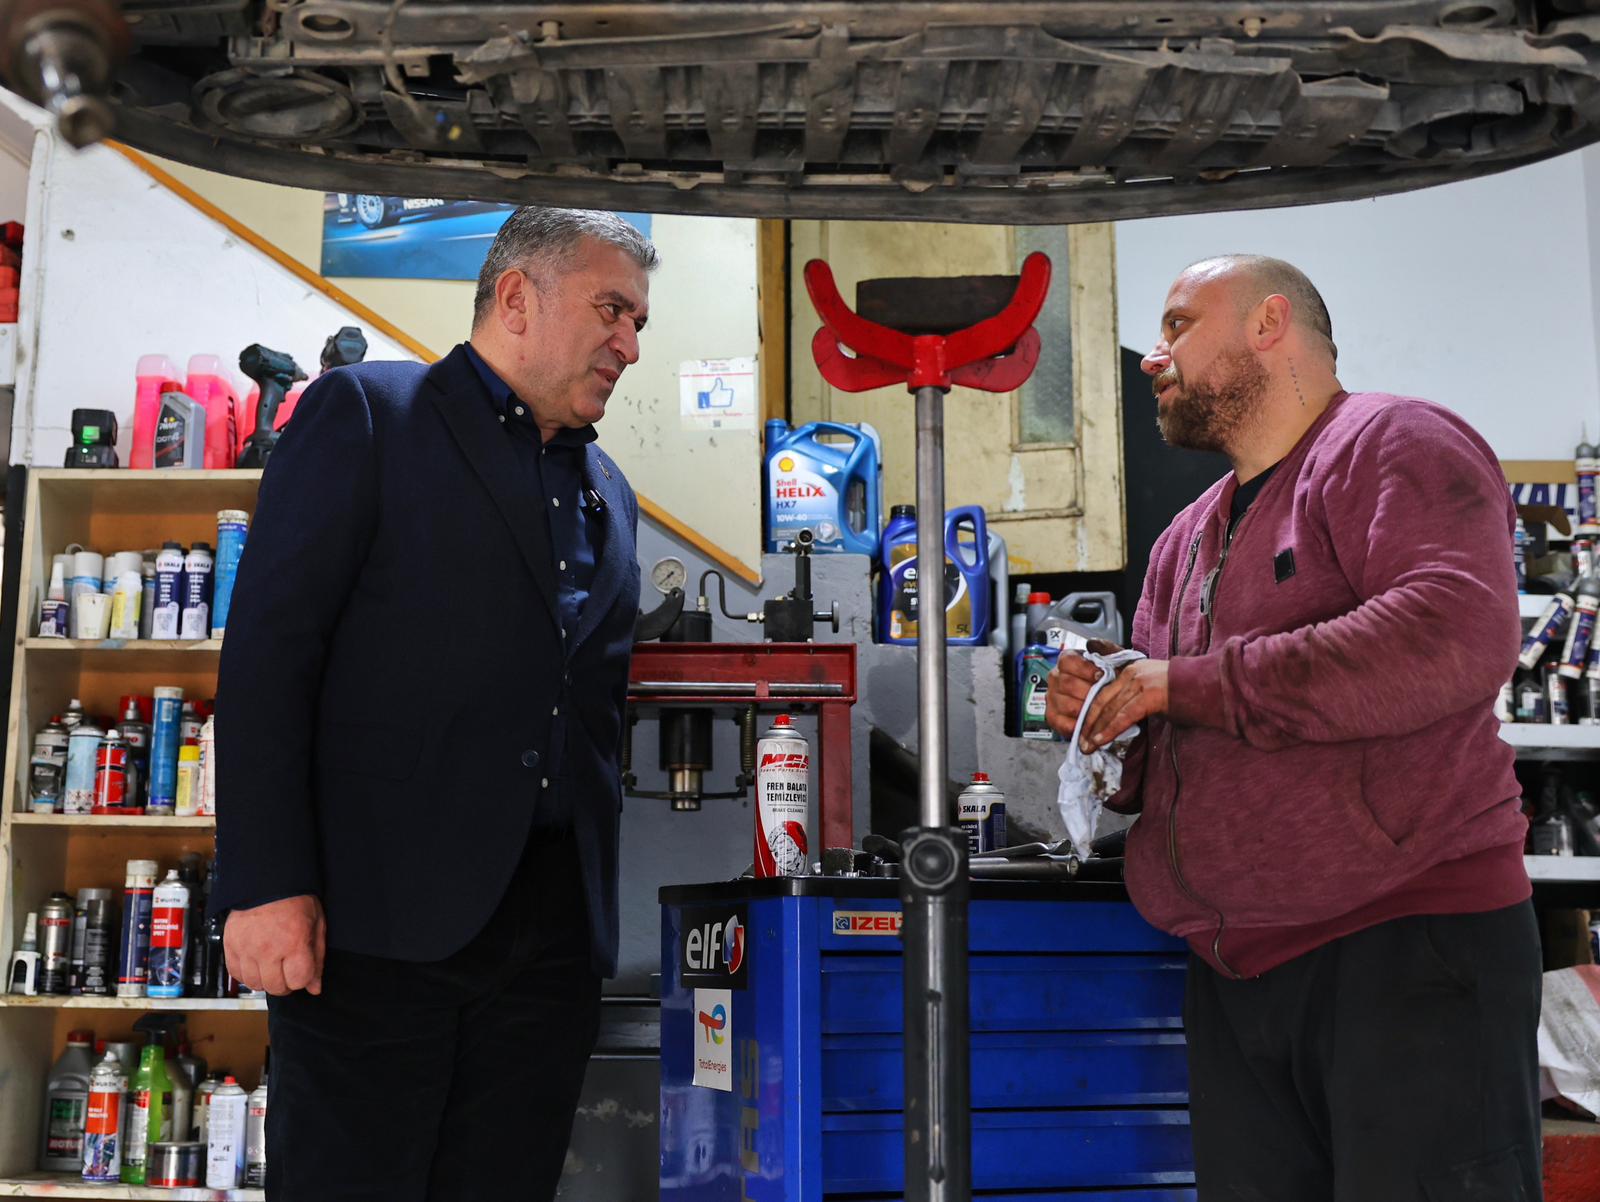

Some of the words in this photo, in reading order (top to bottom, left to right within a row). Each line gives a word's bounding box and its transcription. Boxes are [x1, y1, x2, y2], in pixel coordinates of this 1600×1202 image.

[403, 198, 444, 210] NISSAN
[776, 479, 797, 487] Shell
[776, 487, 826, 498] HELIX
[776, 501, 797, 509] HX7
[776, 513, 808, 522] 10W-40
[766, 782, 785, 791] FREN
[963, 805, 987, 813] SKALA
[851, 916, 904, 930] IZEL
[686, 922, 722, 969] elf
